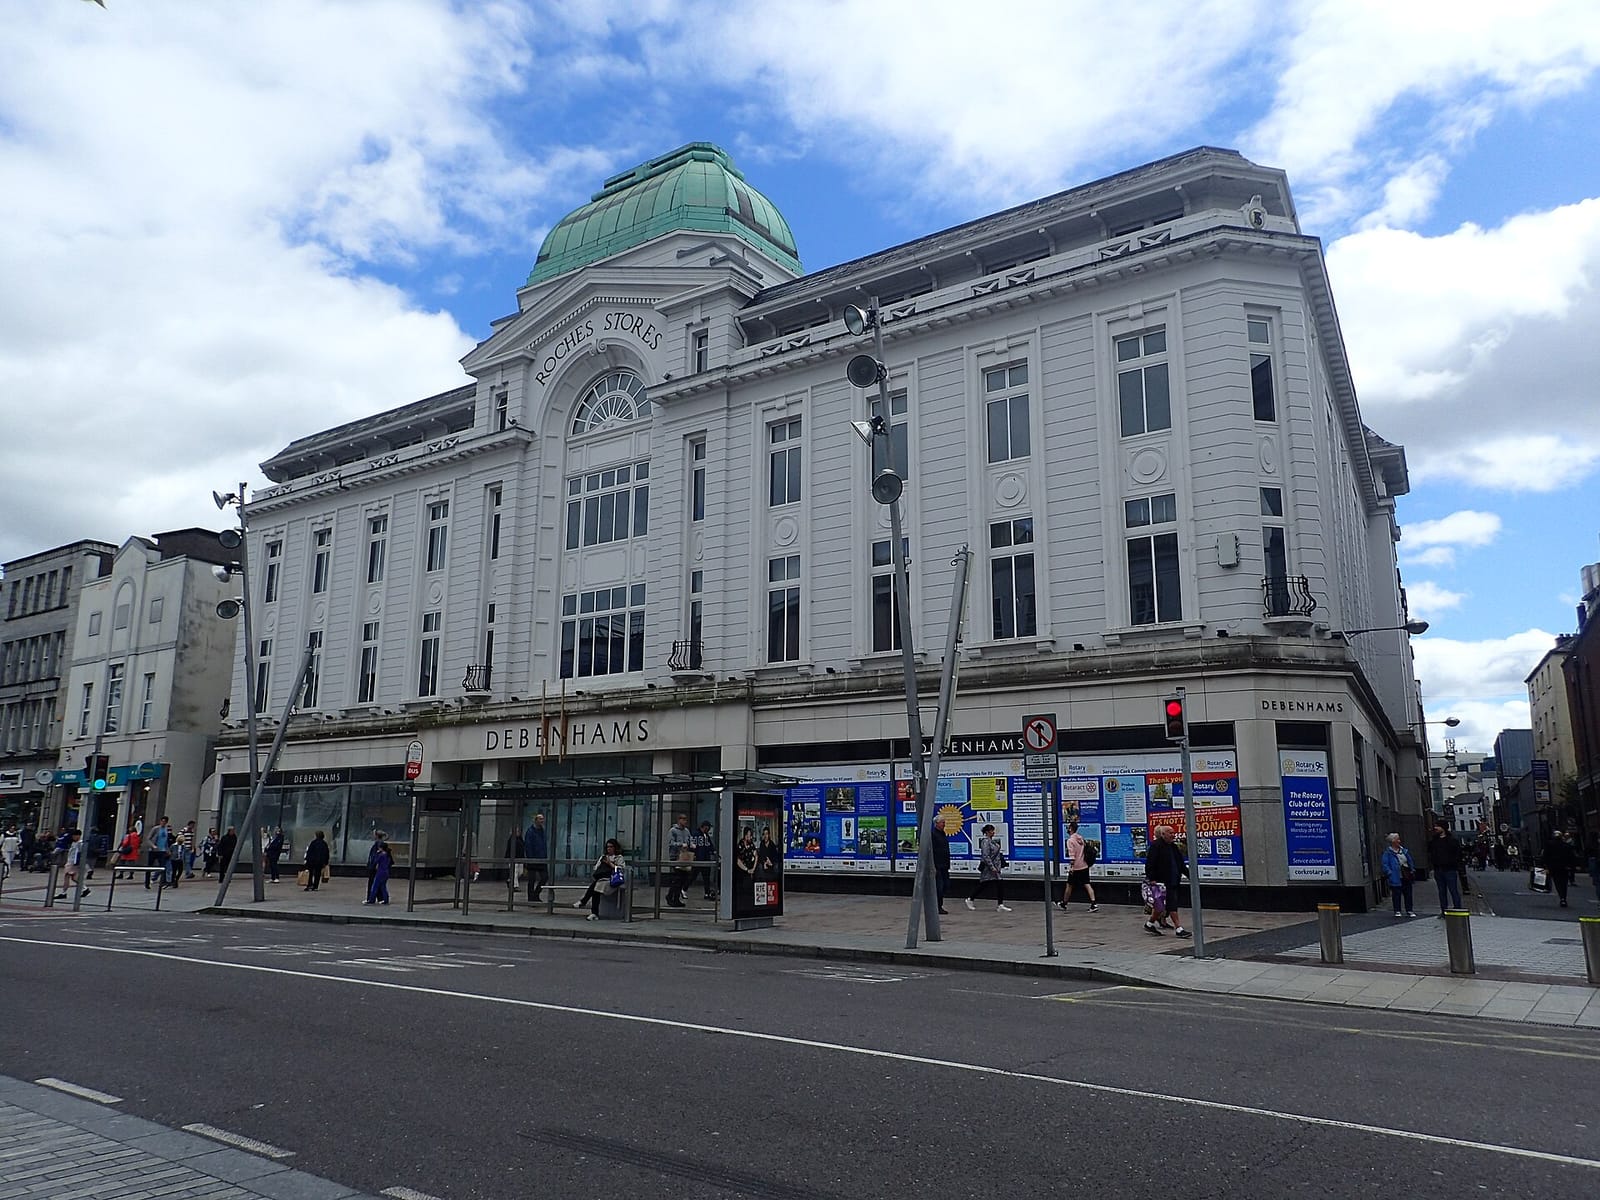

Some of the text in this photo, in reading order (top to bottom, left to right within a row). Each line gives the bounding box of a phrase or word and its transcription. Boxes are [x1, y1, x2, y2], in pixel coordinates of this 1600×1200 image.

[535, 312, 663, 387] ROCHES STORES
[1261, 700, 1343, 713] DEBENHAMS
[486, 719, 648, 750] DEBENHAMS
[921, 738, 1025, 753] ENHAMS
[1296, 760, 1314, 769] Rotary
[294, 772, 340, 783] DEBENHAMS
[1150, 776, 1170, 784] Thank
[1302, 792, 1323, 800] Rotary
[1196, 820, 1238, 831] DONATE
